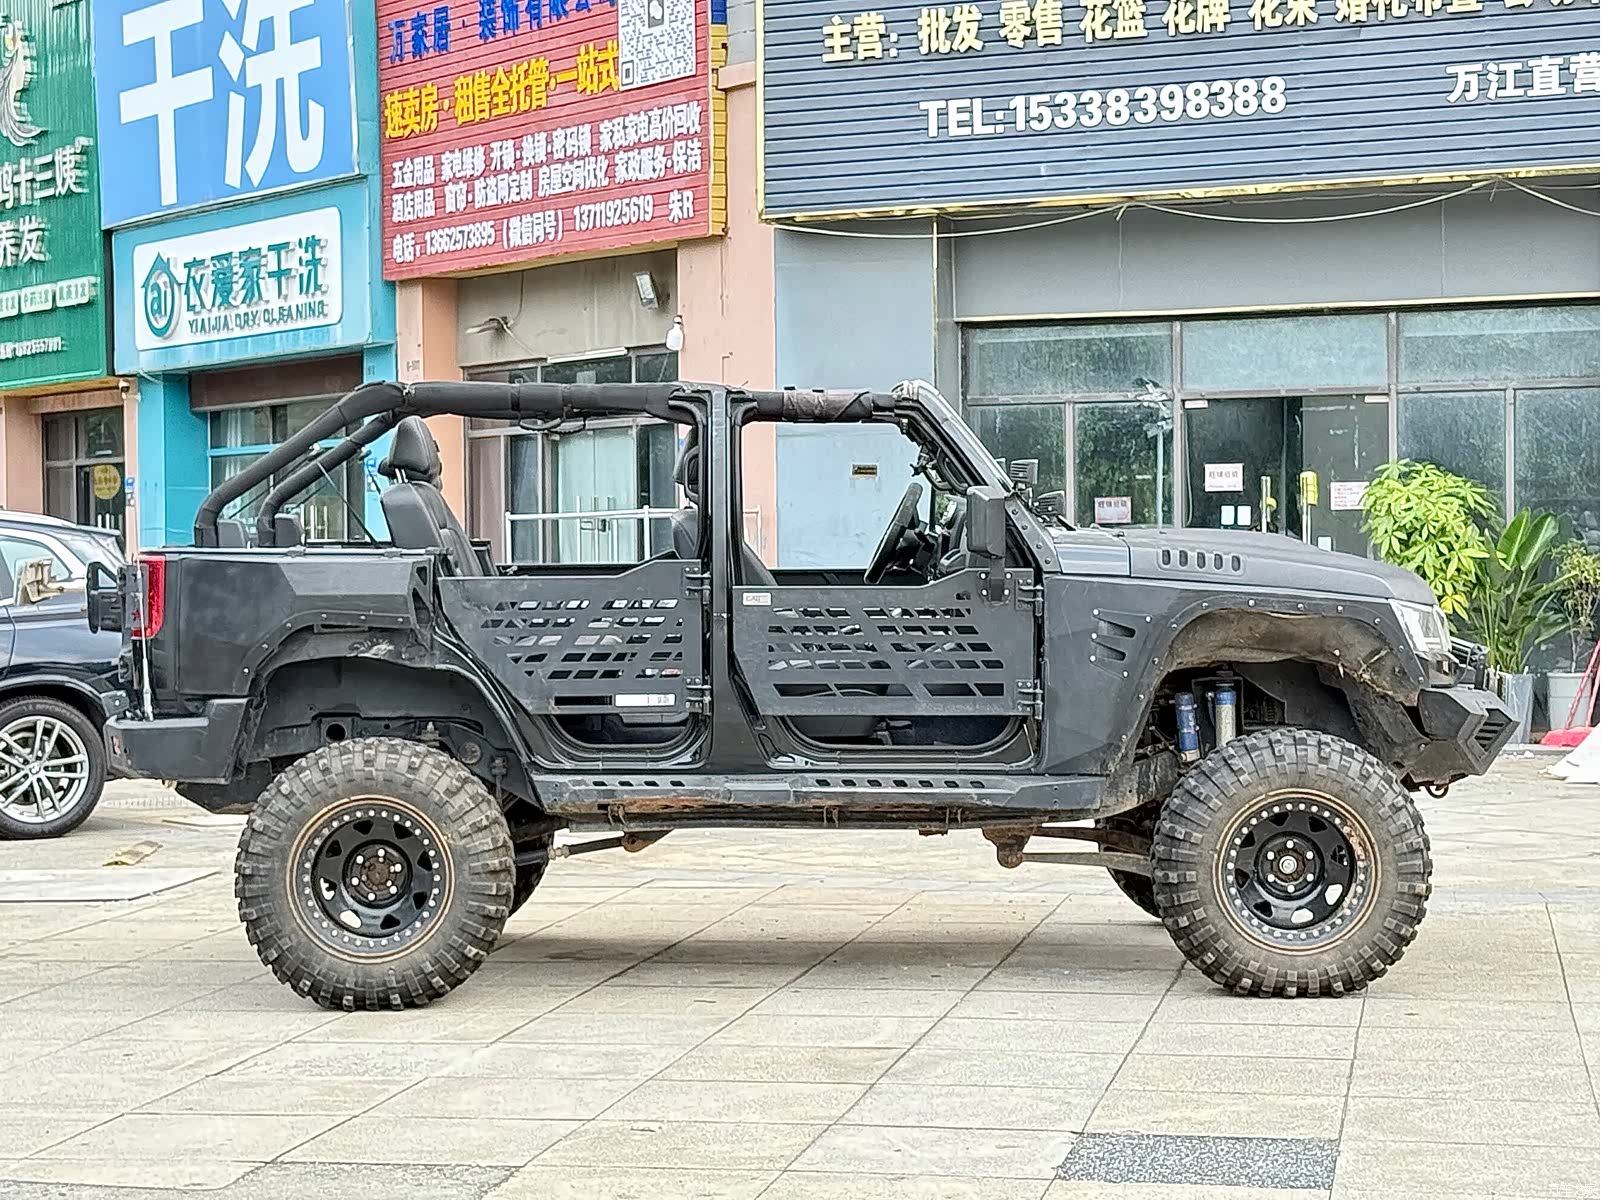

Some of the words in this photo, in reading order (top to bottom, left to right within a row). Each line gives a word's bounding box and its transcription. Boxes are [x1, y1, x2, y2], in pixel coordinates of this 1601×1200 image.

[918, 5, 983, 54] 批发
[999, 0, 1063, 48] 零售
[1079, 0, 1147, 42] 花篮
[1162, 0, 1231, 36] 花牌
[119, 0, 325, 207] 干洗
[919, 76, 1287, 137] TEL:15338398388
[391, 155, 435, 188] 五金用品
[599, 101, 702, 152] 家私家电高价回收
[391, 188, 436, 223] 酒店用品
[537, 155, 609, 197] 房屋空间优化
[573, 194, 654, 231] 13711925619
[184, 235, 326, 312] 衣爱家干洗
